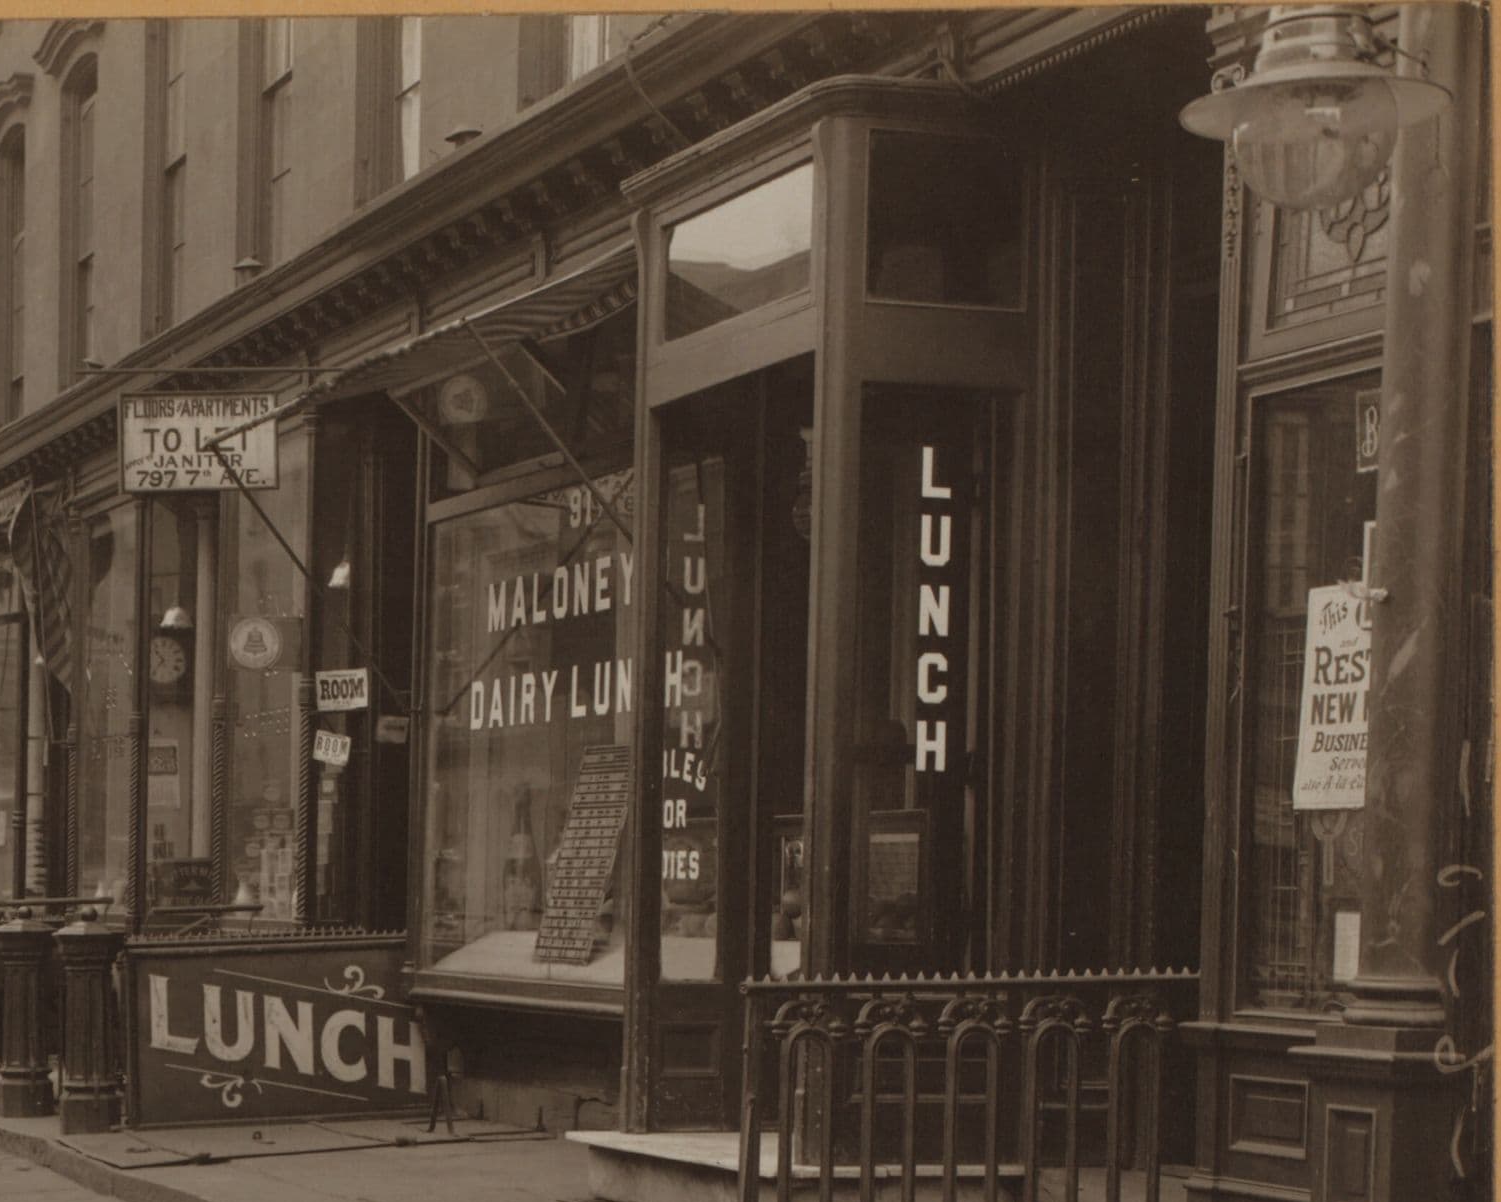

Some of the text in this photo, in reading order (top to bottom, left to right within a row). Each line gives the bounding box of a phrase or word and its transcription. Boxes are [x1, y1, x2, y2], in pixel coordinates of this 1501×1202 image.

[124, 399, 175, 419] FLOORS
[180, 397, 269, 417] APARTMENTS
[143, 426, 247, 453] TO LET
[1362, 405, 1380, 457] B
[154, 453, 243, 469] JANITOR
[136, 470, 177, 488] 797
[488, 551, 635, 633] MALONEY
[916, 446, 952, 772] LUNCH
[320, 677, 365, 700] ROOM
[470, 650, 682, 731] DAIRY LUNH
[1310, 692, 1358, 726] NEW
[1311, 731, 1369, 753] BUSINE
[663, 748, 706, 792] LES
[662, 799, 687, 829] OR
[148, 973, 428, 1094] LUNCH
